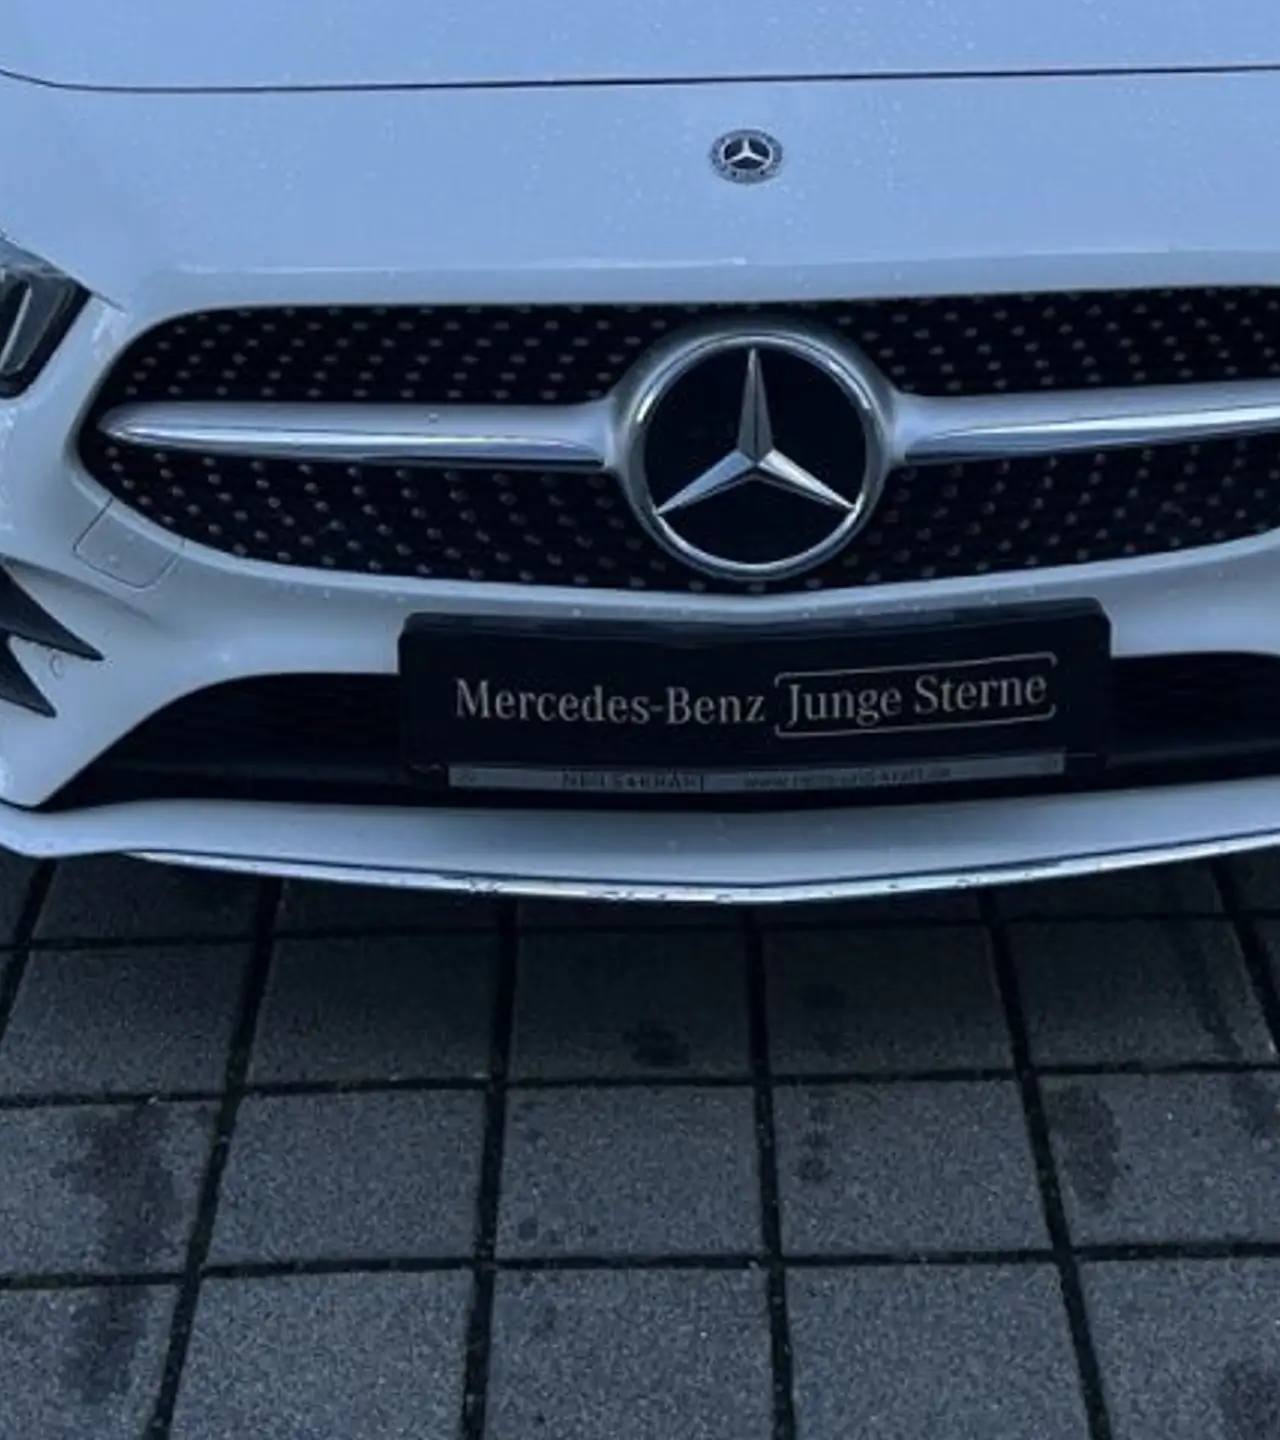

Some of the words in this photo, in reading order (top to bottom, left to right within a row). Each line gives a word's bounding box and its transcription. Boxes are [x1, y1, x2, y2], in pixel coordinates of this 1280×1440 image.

[455, 676, 766, 725] Mercedes-Benz
[785, 683, 904, 728] Junge
[914, 673, 1048, 715] Sterne
